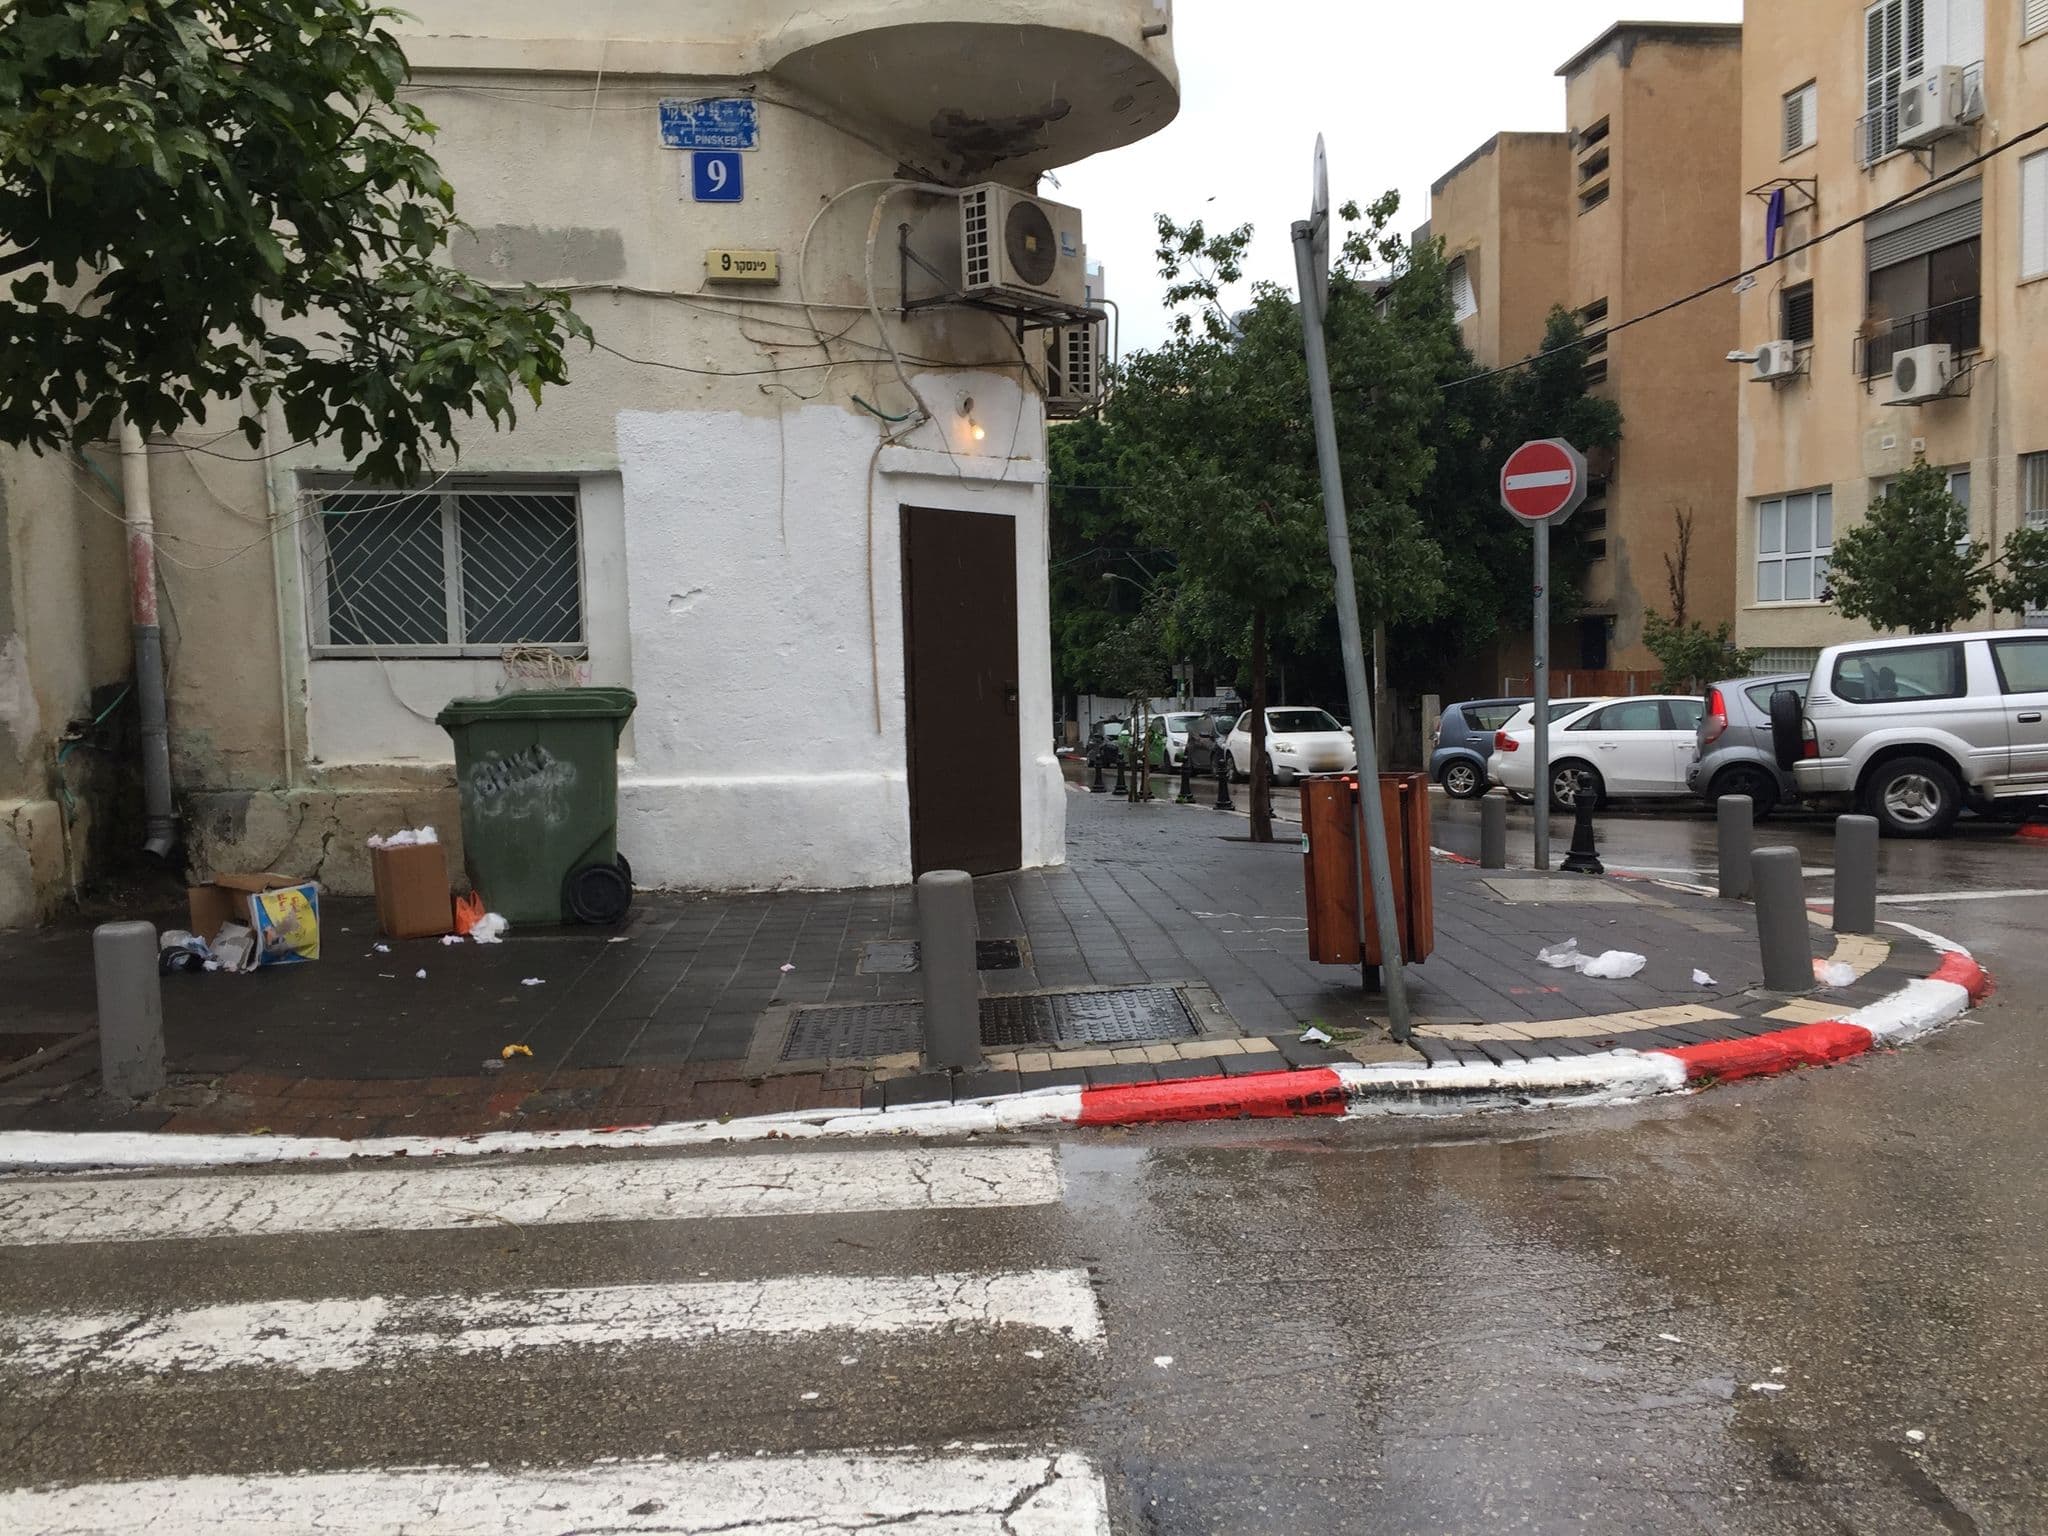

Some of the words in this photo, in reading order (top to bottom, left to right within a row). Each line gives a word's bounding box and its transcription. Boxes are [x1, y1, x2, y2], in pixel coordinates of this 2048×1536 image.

[707, 160, 727, 192] 9
[721, 253, 731, 271] 9
[734, 260, 767, 274] פינסקר
